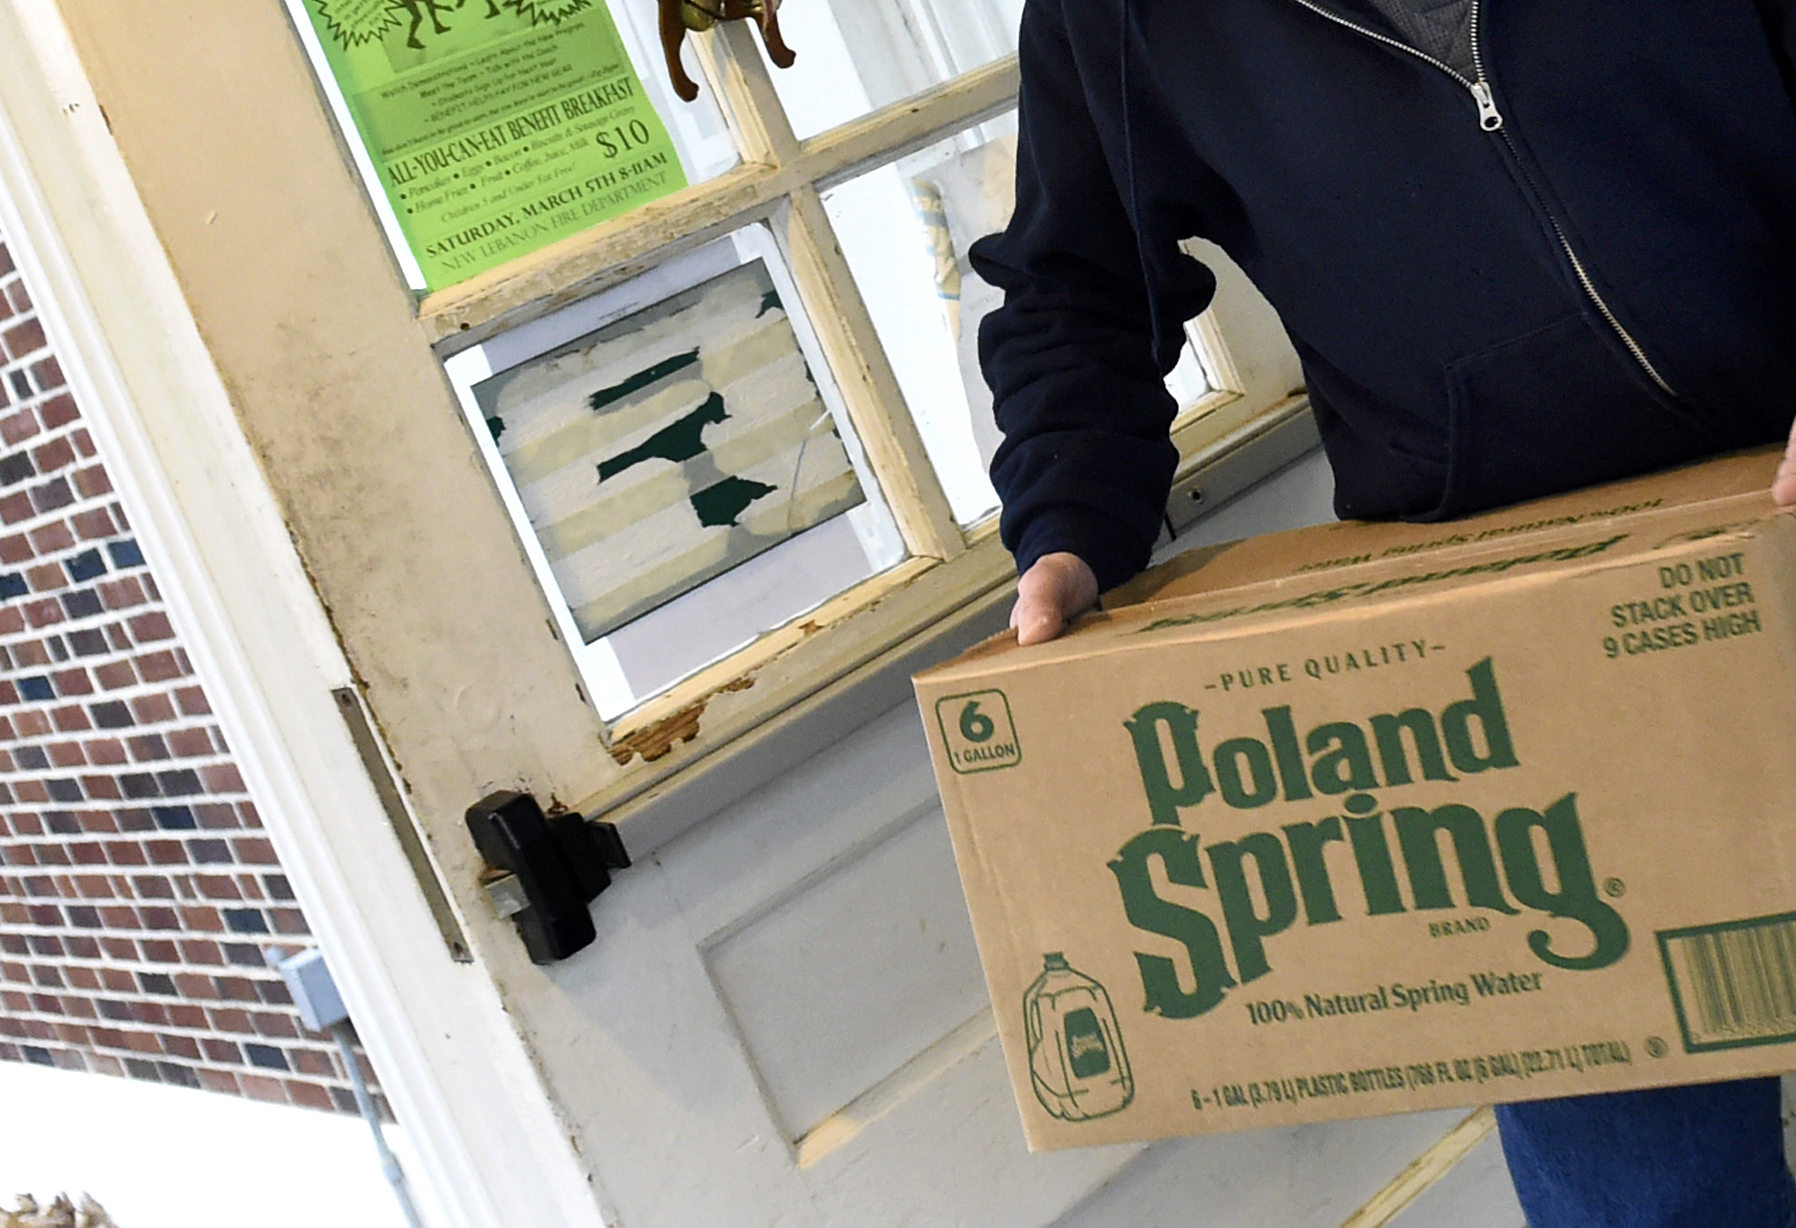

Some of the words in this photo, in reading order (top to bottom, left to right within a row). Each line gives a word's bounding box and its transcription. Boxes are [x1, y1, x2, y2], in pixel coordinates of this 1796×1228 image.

[384, 124, 509, 187] ALL-YOU-CAN-EAT
[505, 103, 563, 141] BENEFIT
[560, 75, 636, 120] BREAKFAST
[593, 115, 652, 161] $10
[424, 210, 521, 260] SATURDAY,
[521, 185, 583, 220] MARCH
[584, 171, 617, 195] 5TH
[617, 150, 668, 181] 8-11AM
[440, 248, 478, 274] NEW
[479, 219, 549, 258] LEBANON
[550, 207, 580, 229] FIRE
[580, 170, 669, 216] DEPARTMENT
[1658, 561, 1694, 589] DO
[1696, 551, 1748, 581] NOT
[1610, 594, 1687, 628] STACK
[1687, 581, 1755, 613] OVER
[1602, 636, 1619, 658] 9
[1620, 621, 1700, 655] CASES
[1701, 610, 1762, 640] HIGH
[954, 698, 997, 745] 6
[1123, 655, 1521, 827] Poland
[954, 752, 961, 764] 1
[962, 742, 1015, 762] GALLON
[1106, 792, 1631, 1021] Spring
[1428, 917, 1491, 939] BRAND
[1245, 996, 1305, 1026] 100%
[1303, 985, 1390, 1019] Natural
[1390, 975, 1470, 1012] Spring
[1470, 966, 1545, 998] Water
[1190, 1089, 1202, 1110] 6
[1212, 1087, 1222, 1107] 1
[1222, 1084, 1249, 1106] GAL
[1247, 1080, 1284, 1108] (3.79
[1295, 1073, 1349, 1099] PLASTIC
[1348, 1067, 1405, 1093] BOTTLES
[1435, 1060, 1454, 1083] FL
